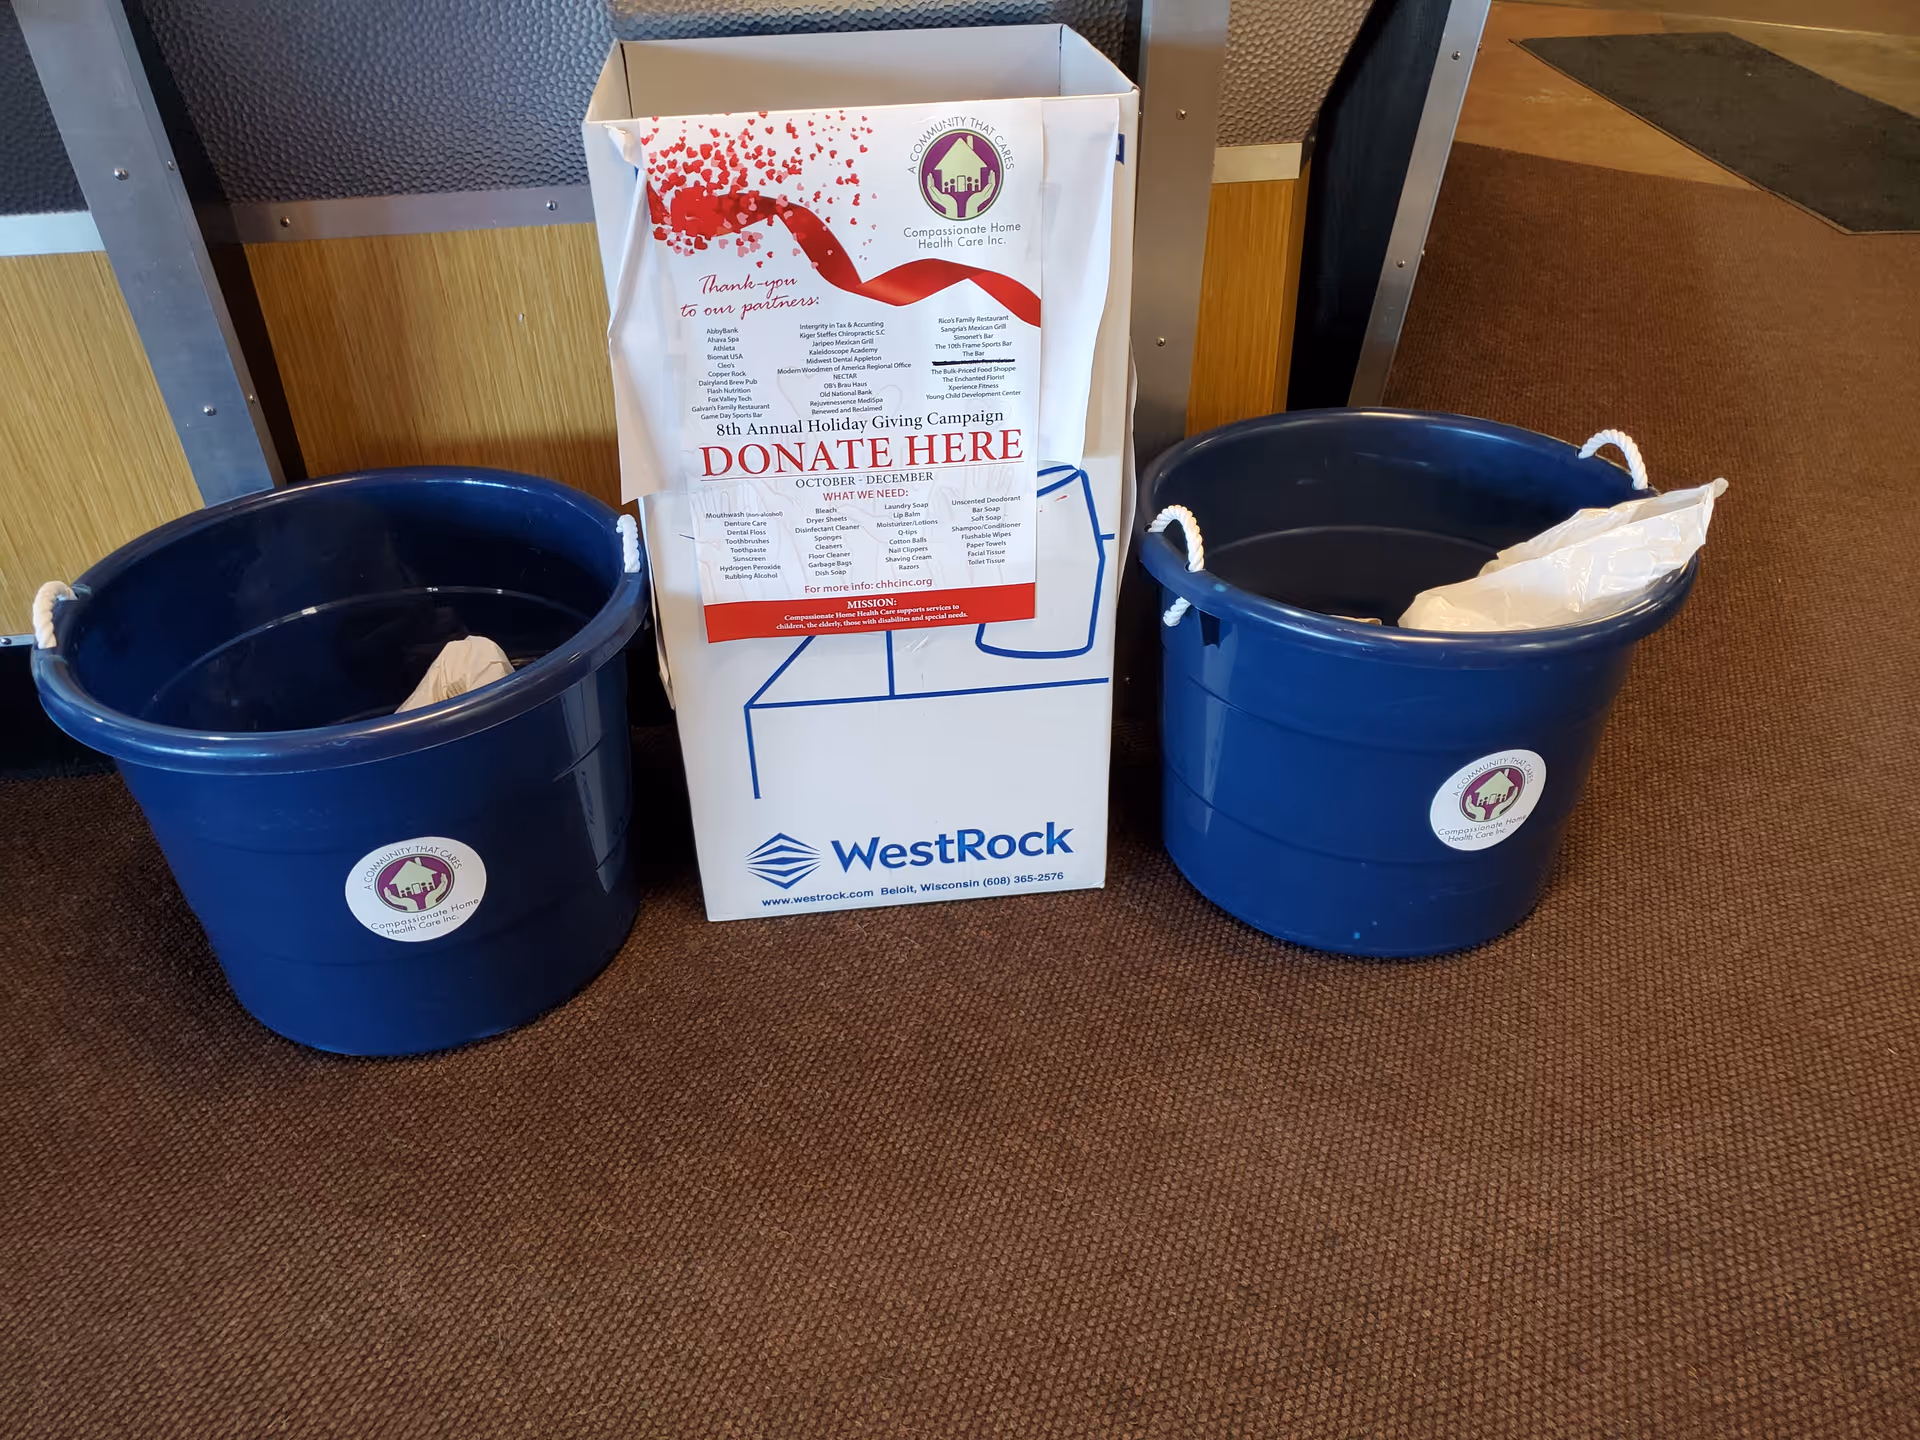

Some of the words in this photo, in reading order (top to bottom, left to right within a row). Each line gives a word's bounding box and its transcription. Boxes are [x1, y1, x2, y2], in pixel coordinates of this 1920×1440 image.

[970, 118, 996, 136] THAT
[910, 116, 966, 162] COMMUNITY
[994, 135, 1014, 169] CARES
[908, 166, 916, 174] A
[904, 225, 986, 239] Compassionate
[991, 222, 1021, 232] Home
[918, 237, 952, 249] Health
[958, 236, 983, 246] Care
[988, 236, 1006, 245] Inc.
[699, 274, 797, 299] Thank-you
[680, 304, 698, 317] to
[704, 306, 735, 316] our
[740, 295, 819, 320] partners:
[955, 317, 975, 325] Family
[706, 327, 738, 336] AbbyBank
[981, 341, 1000, 349] Sports
[809, 348, 848, 357] Kaleidoscope
[850, 347, 878, 355] Academy
[993, 366, 1016, 374] Shoppe
[948, 384, 977, 392] Xperience
[716, 422, 740, 436] 8th
[746, 419, 802, 434] Annual
[808, 416, 866, 435] Holiday
[872, 414, 922, 432] Giving
[927, 410, 1003, 429] Campaign
[699, 436, 892, 476] DONATE
[906, 429, 1024, 465] HERE
[796, 475, 854, 489] OCTOBER
[866, 471, 933, 485] DECEMBER
[822, 490, 853, 501] WHAT
[857, 490, 873, 500] WE
[876, 488, 908, 499] NEED:
[885, 503, 910, 511] Laundry
[984, 506, 1000, 514] Soap
[877, 519, 938, 529] Moisturizer/Lotions
[952, 522, 1021, 533] Shampoo/Conditioner
[814, 534, 842, 542] Sponges
[992, 532, 1011, 540] Wipes
[902, 546, 928, 554] Clippers
[966, 541, 984, 549] Paper
[885, 555, 910, 563] Shaving
[808, 561, 835, 569] Garbage
[830, 569, 846, 577] Soap
[804, 584, 820, 593] For
[851, 581, 873, 590] info:
[875, 578, 932, 591] chhcinc.org
[847, 598, 897, 609] MISSION:
[831, 821, 1074, 873] WestRock
[364, 847, 411, 883] COMMUNITY
[440, 849, 462, 869] CARES
[762, 889, 873, 907] www.westrock.com
[881, 886, 917, 896] Beloit,
[921, 879, 979, 891] Wisconsin
[983, 876, 1010, 887] (608)
[1014, 872, 1063, 883] 365-2576
[371, 910, 448, 930] Compassionate
[451, 899, 478, 912] Home
[387, 926, 416, 935] Health
[419, 919, 441, 928] Care
